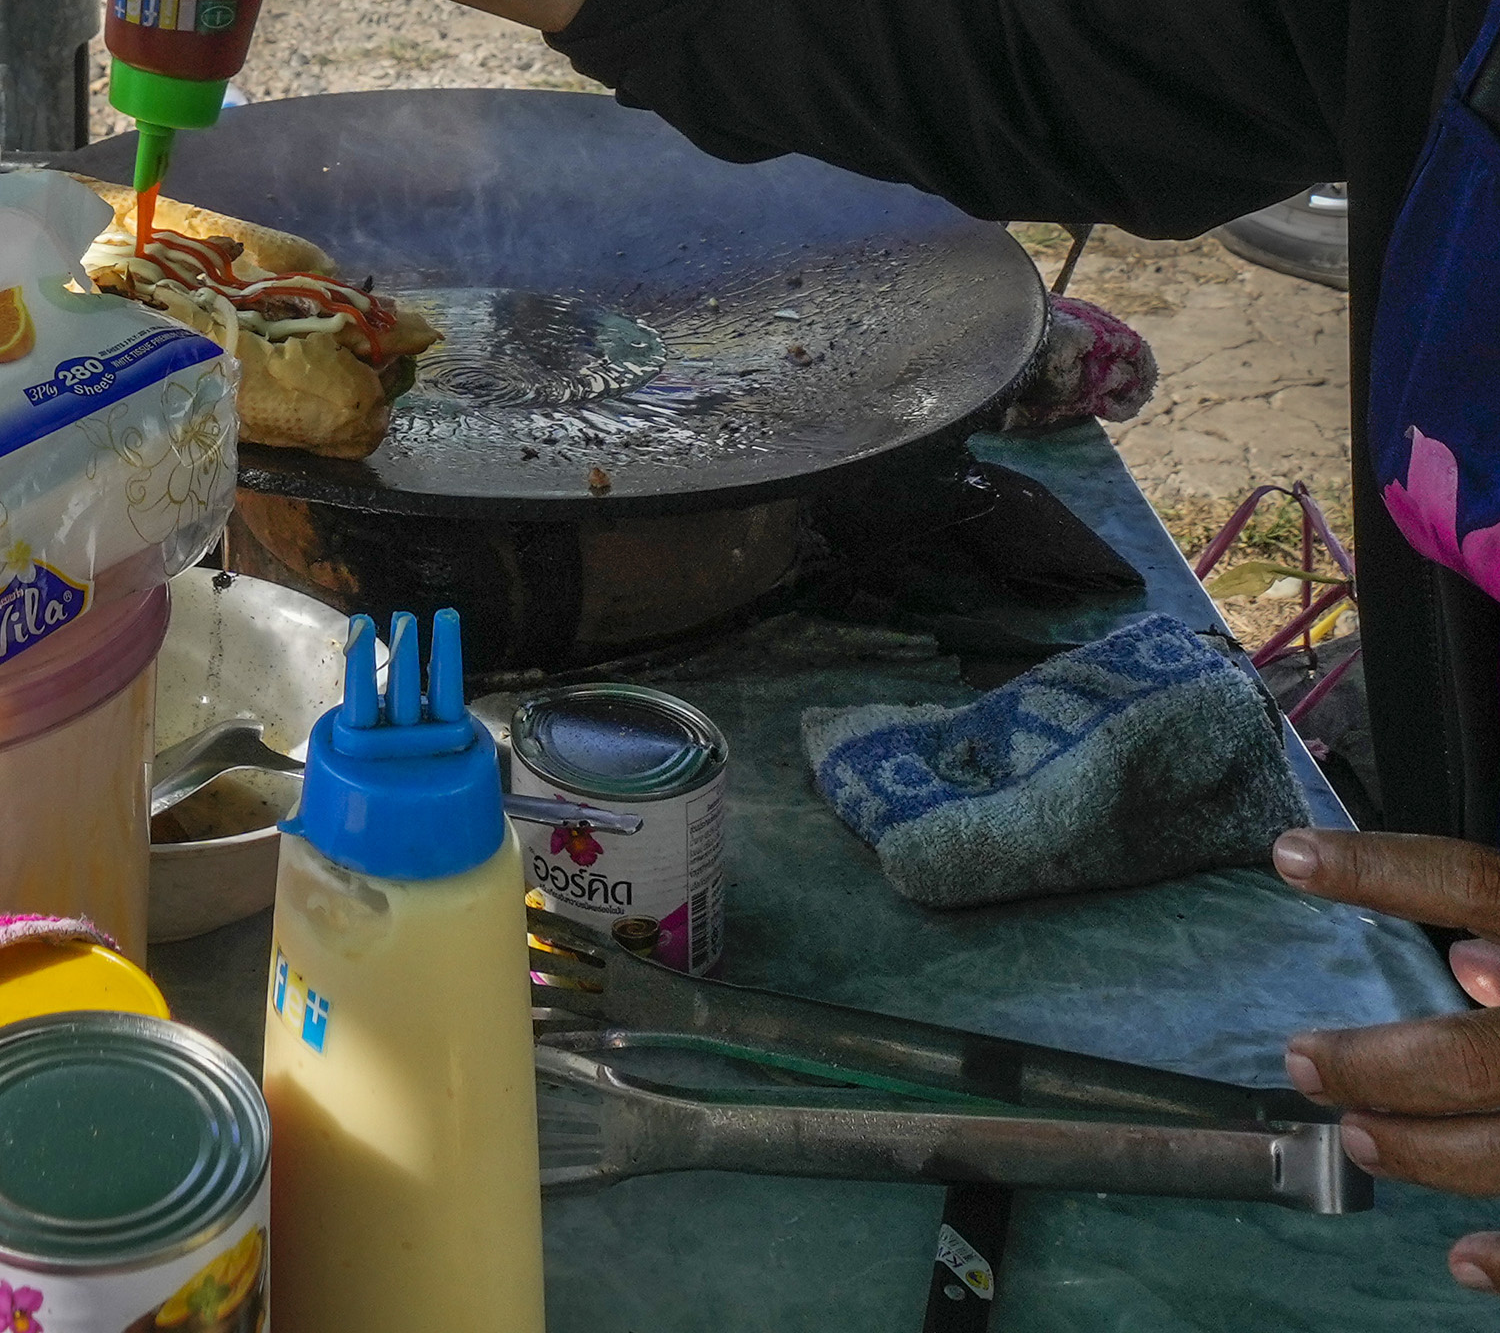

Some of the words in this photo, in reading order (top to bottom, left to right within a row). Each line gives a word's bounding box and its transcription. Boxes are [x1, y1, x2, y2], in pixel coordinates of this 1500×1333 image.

[110, 354, 133, 369] WHITE
[129, 341, 154, 357] TISSUE
[58, 359, 103, 386] 280
[73, 372, 115, 396] Sheets
[29, 383, 59, 402] 3Ply
[533, 855, 633, 906] ออร์คิด
